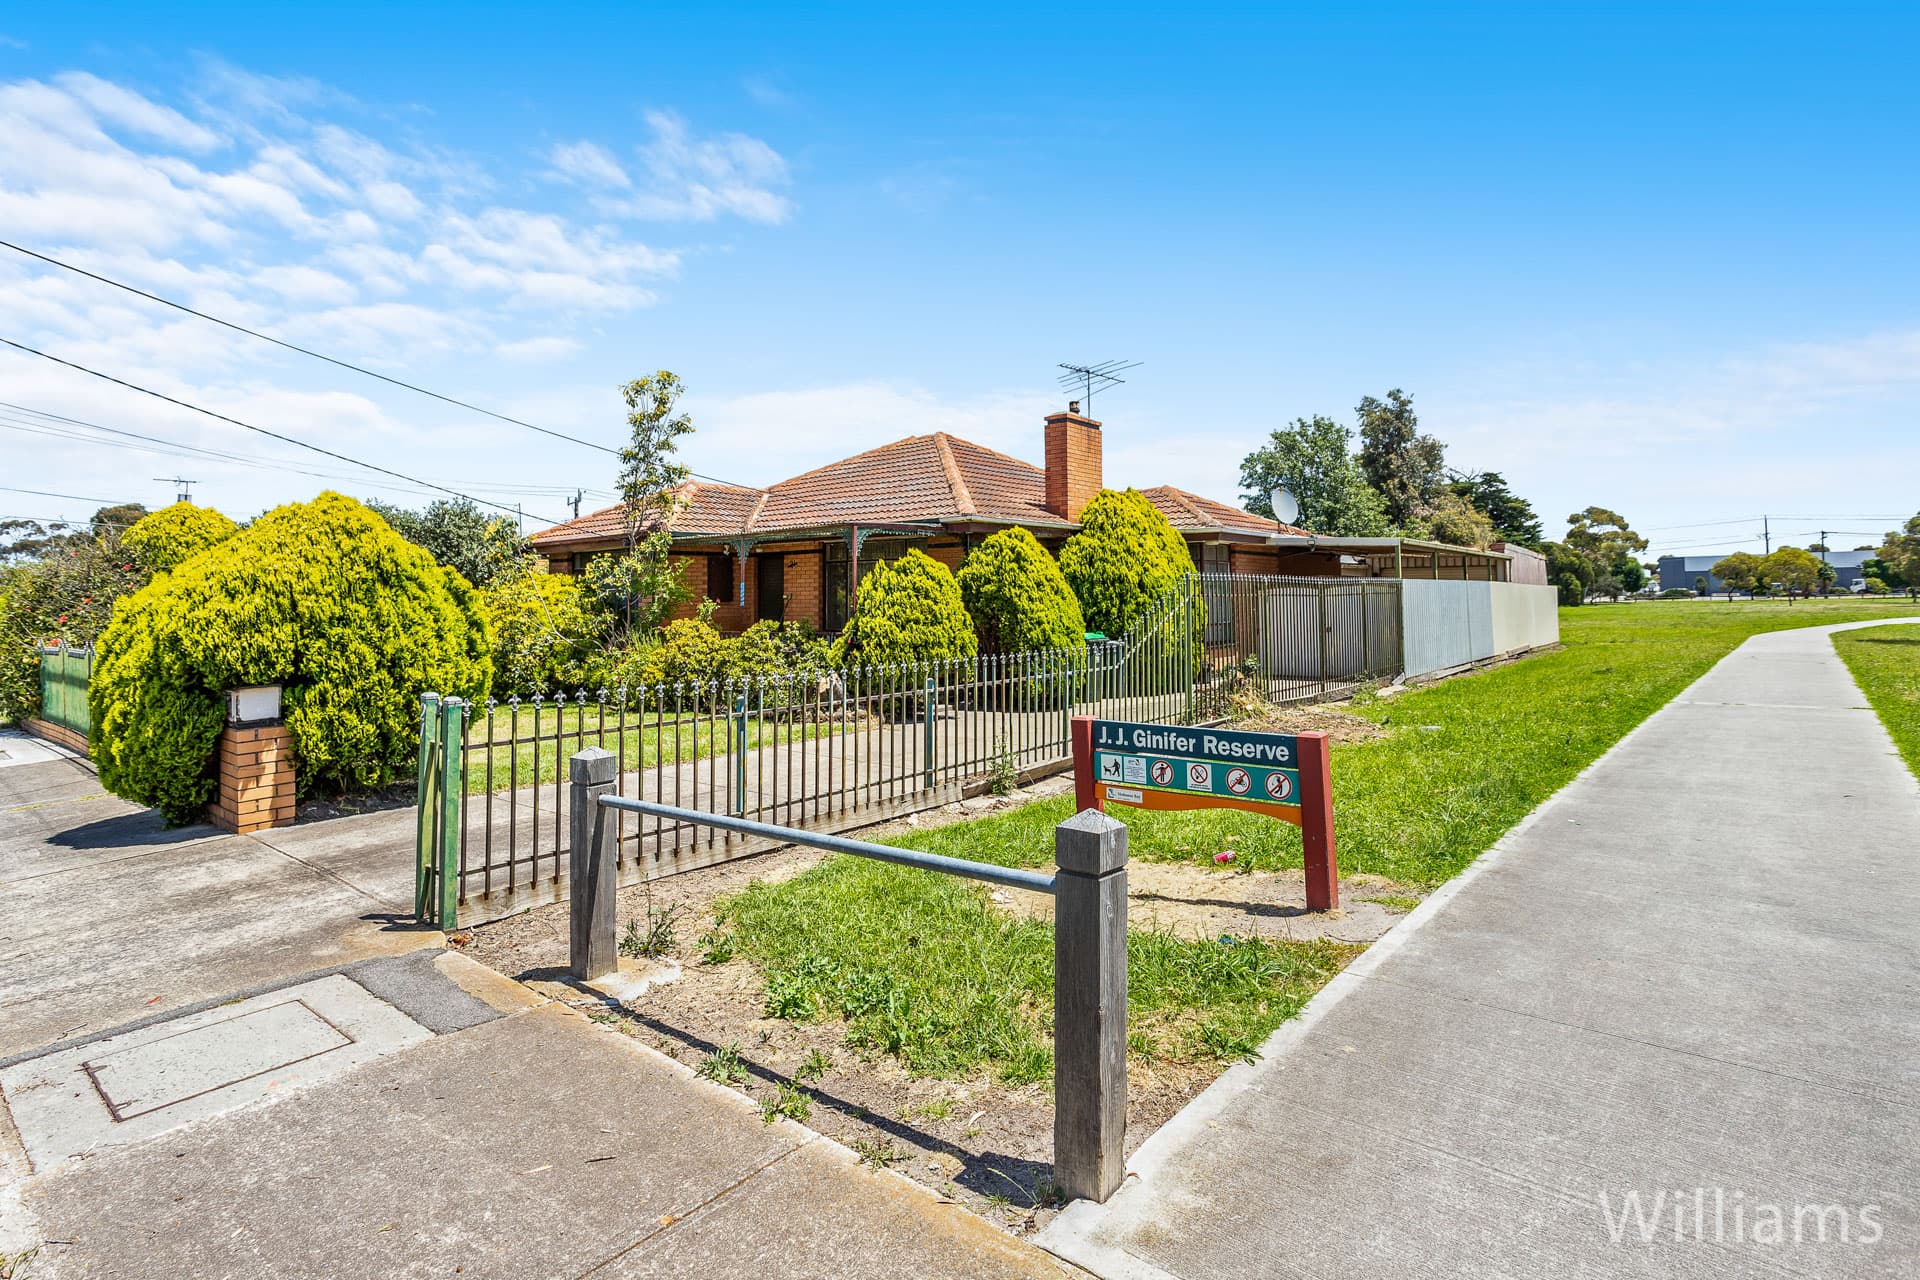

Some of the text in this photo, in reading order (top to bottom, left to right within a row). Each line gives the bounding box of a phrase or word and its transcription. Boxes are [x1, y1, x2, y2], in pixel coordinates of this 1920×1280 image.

[1099, 726, 1290, 762] J. J. Ginifer Reserve
